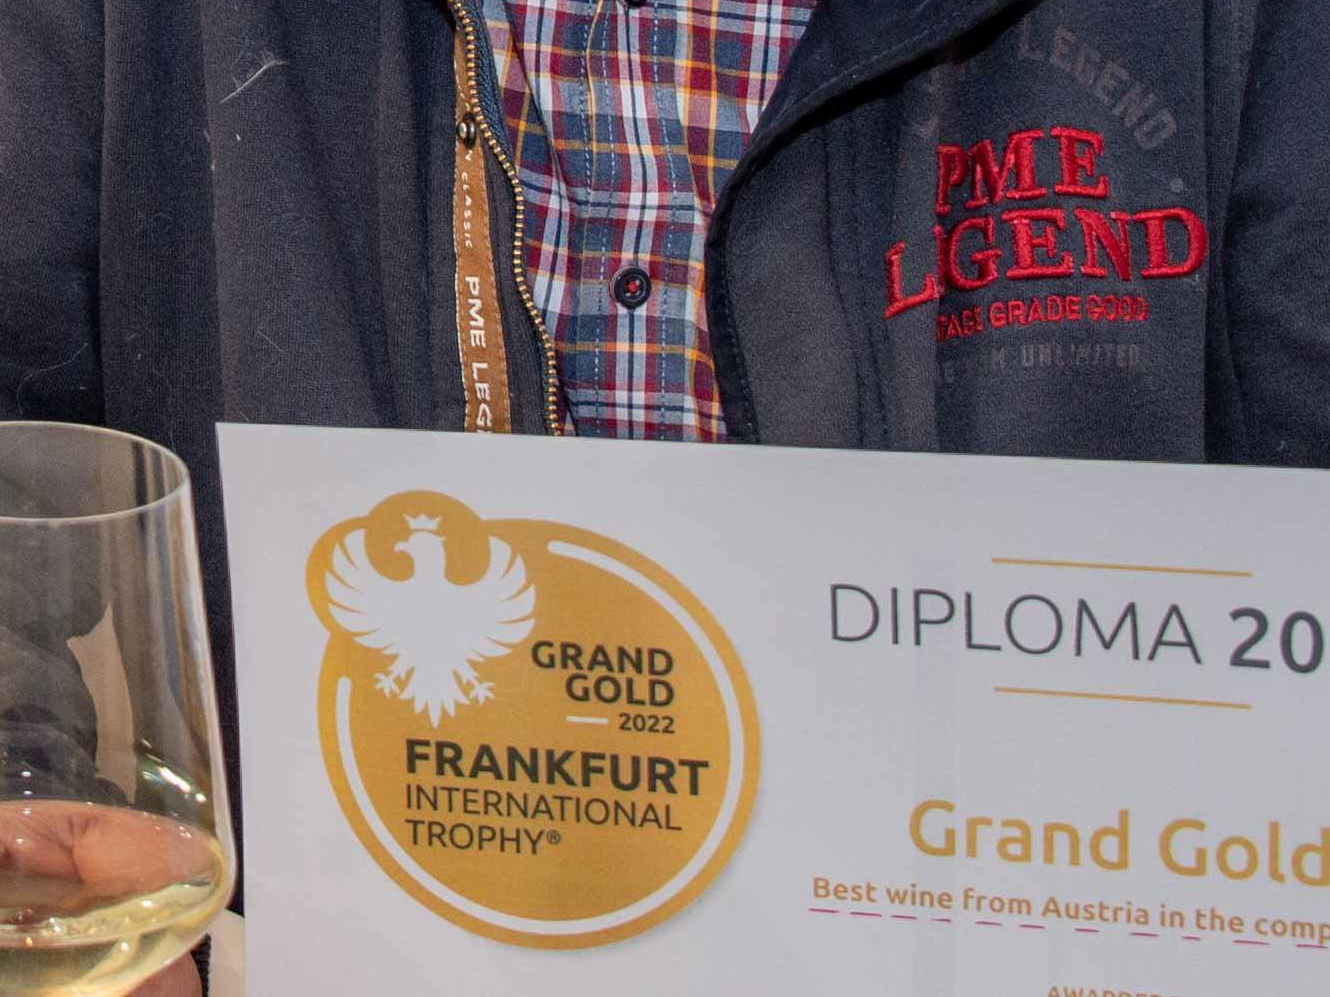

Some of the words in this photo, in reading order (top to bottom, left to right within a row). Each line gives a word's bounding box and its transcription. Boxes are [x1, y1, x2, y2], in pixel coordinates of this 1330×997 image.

[935, 125, 1109, 215] PME
[459, 172, 474, 249] CLASSIC
[884, 207, 1209, 319] LGEND
[465, 275, 487, 349] PME
[988, 295, 1082, 329] GRADE
[470, 362, 493, 433] LEG
[531, 640, 674, 677] GRAND
[830, 584, 1202, 664] DIPLOMA
[1229, 606, 1325, 674] 20
[565, 673, 674, 708] GOLD
[618, 713, 675, 735] 2022
[405, 738, 710, 796] FRANKFURT
[405, 783, 682, 831] INTERNATIONAL
[909, 799, 1129, 872] Grand
[1159, 818, 1330, 888] Gold
[813, 877, 877, 903] Best
[886, 883, 953, 909] wine
[963, 888, 1032, 917] from
[1042, 896, 1150, 926] Austria
[1160, 905, 1185, 929] in
[1194, 908, 1244, 934] the
